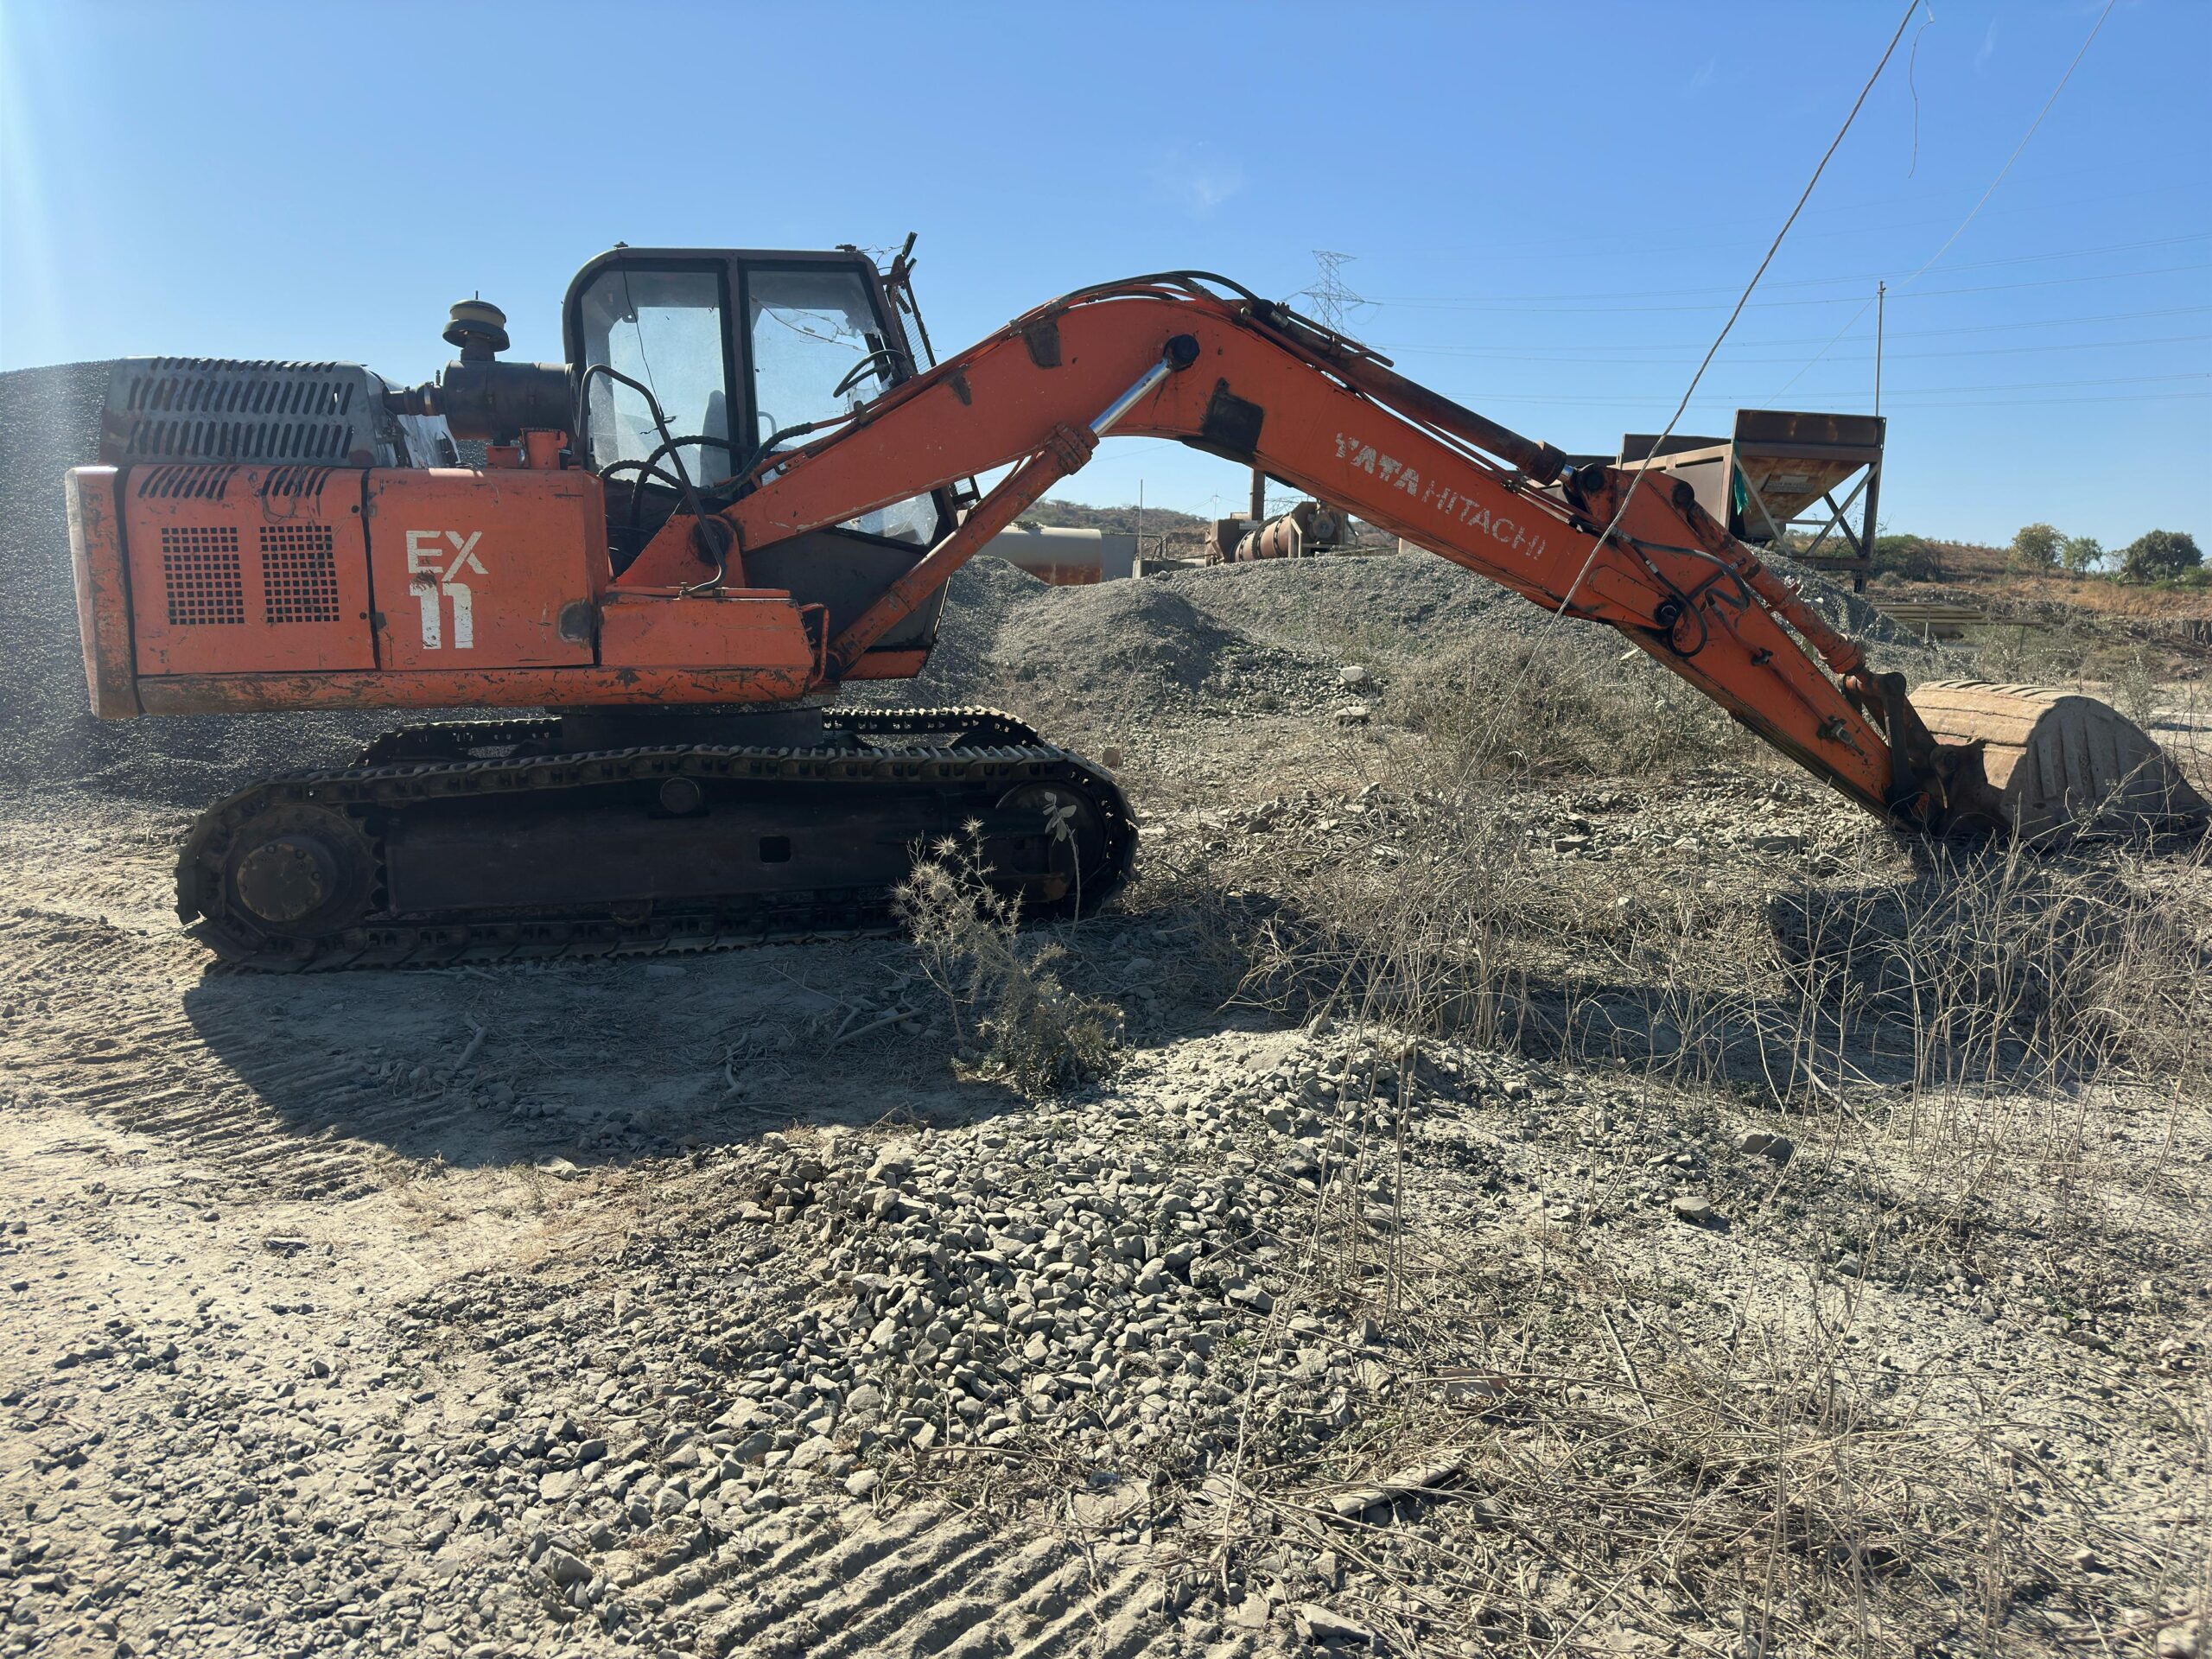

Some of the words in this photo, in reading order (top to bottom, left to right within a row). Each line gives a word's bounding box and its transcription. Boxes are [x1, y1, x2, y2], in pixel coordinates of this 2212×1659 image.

[1422, 480, 1547, 560] HITACHI
[406, 531, 489, 582] EX
[410, 582, 474, 649] 11
